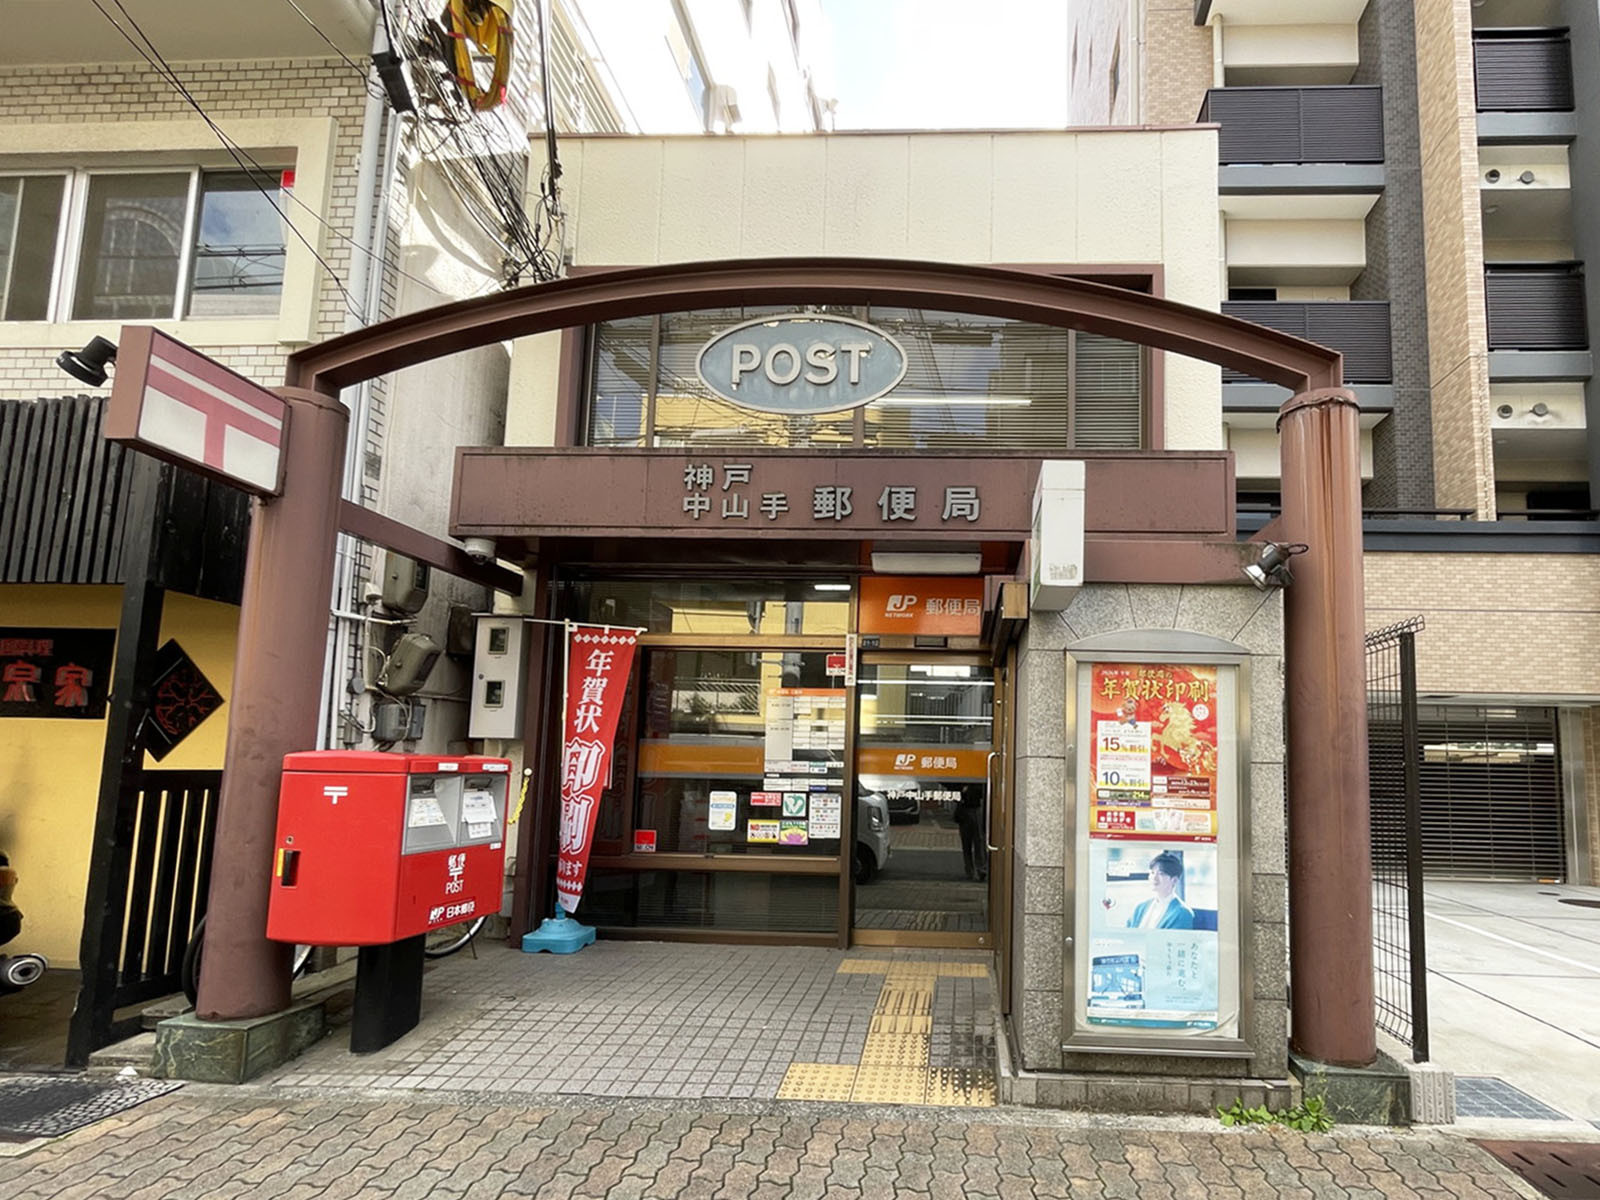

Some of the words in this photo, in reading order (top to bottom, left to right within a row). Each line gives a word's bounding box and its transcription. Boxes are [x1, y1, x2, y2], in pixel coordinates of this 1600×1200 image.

[731, 342, 872, 386] POST
[682, 463, 753, 491] 神戸
[682, 492, 789, 520] 中山手
[813, 485, 982, 522] 郵便局
[886, 595, 917, 612] JP
[925, 598, 981, 617] 郵便局
[1100, 677, 1210, 703] 年賀状印刷
[921, 756, 957, 769] 郵便局
[887, 789, 962, 802] 神戸中山手郵便局
[448, 853, 467, 870] 郵便
[445, 879, 464, 895] POST
